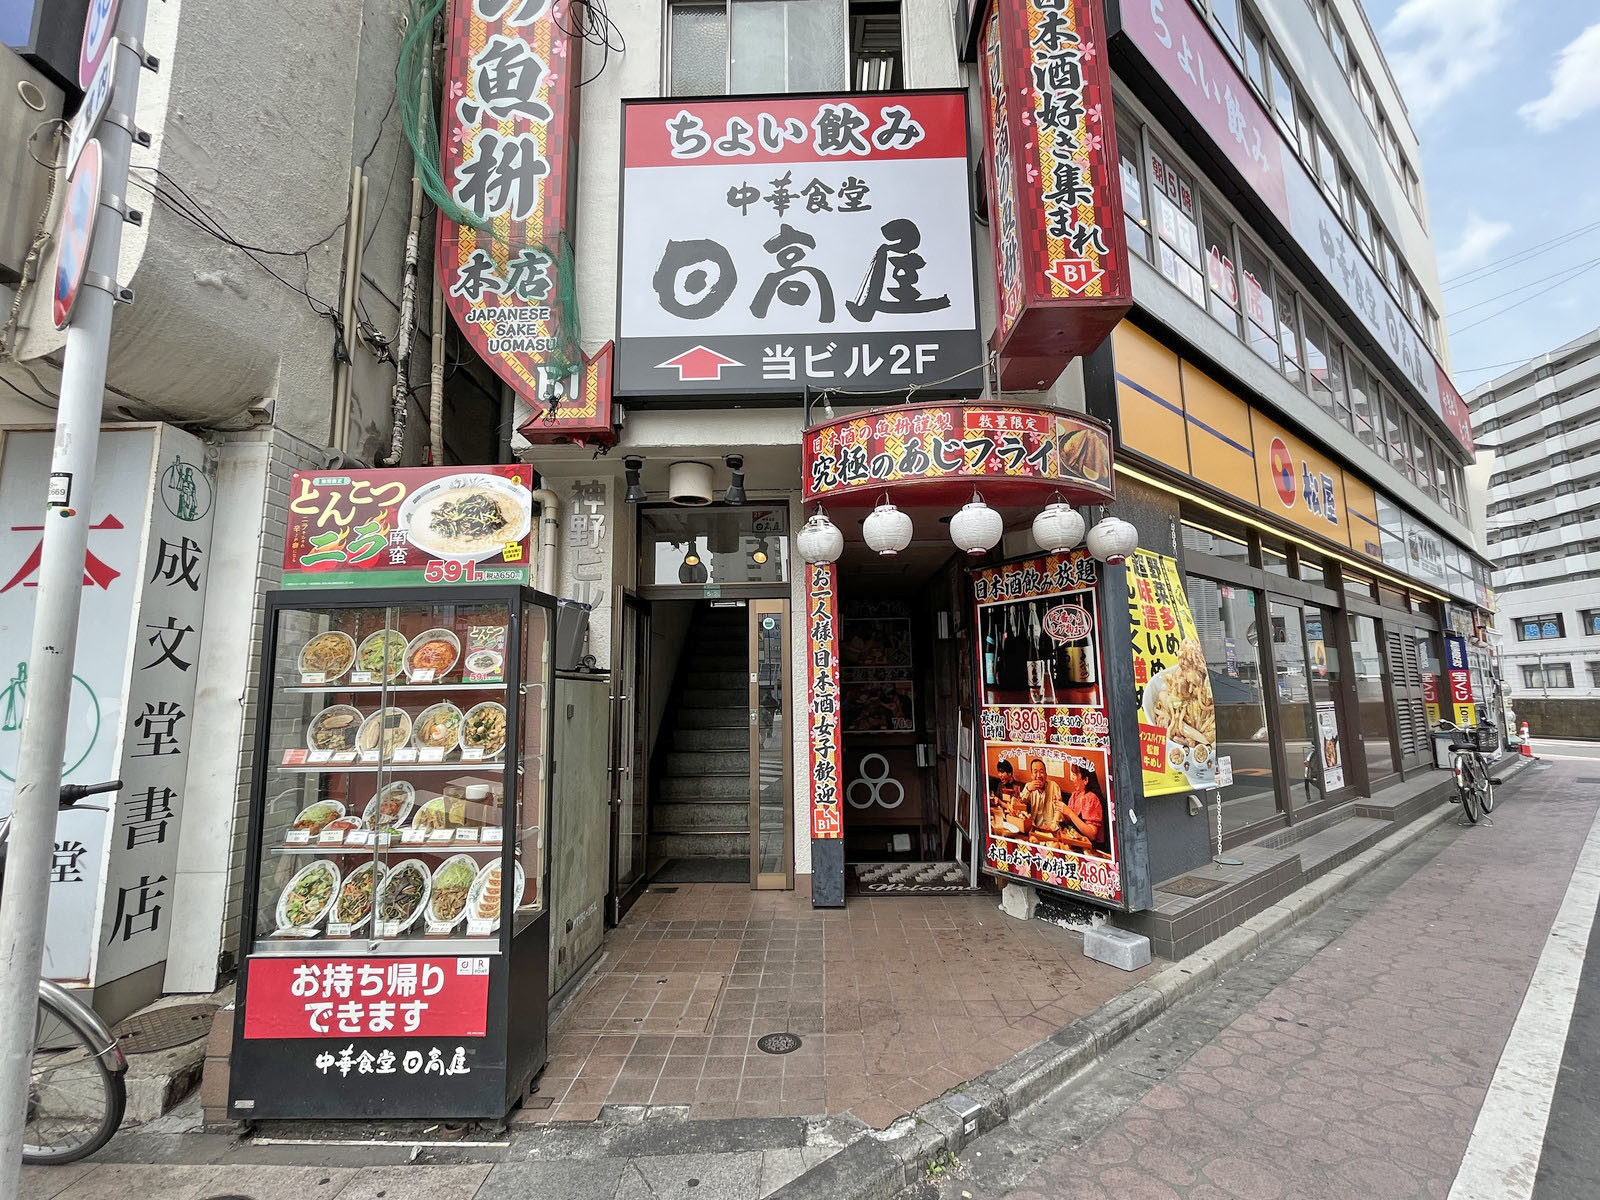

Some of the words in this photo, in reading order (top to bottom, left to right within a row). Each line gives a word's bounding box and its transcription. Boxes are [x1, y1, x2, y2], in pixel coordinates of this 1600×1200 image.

[667, 103, 925, 158] ちょい飲み
[727, 170, 872, 217] 中華食堂
[451, 250, 553, 301] 本店
[653, 218, 950, 323] 日高屋
[1064, 265, 1087, 282] B1
[467, 308, 550, 321] JAPANESE
[496, 324, 537, 336] SAKE
[489, 338, 557, 351] UOMASU
[762, 343, 939, 380] 当ビル2F
[812, 412, 953, 454] 日本酒の魚枡謹製
[978, 412, 1039, 431] 数量限定
[811, 436, 1056, 492] 究極のあじフライ
[290, 479, 406, 527] とんこつ
[1301, 459, 1338, 526] 松屋
[300, 521, 389, 567] ニラ
[389, 529, 409, 565] 南蛮
[570, 480, 606, 609] 神野ビル
[424, 560, 483, 582] 591円
[975, 557, 1097, 600] 日本酒飲み放題
[107, 536, 202, 947] 成文堂書店
[818, 819, 831, 830] B1
[988, 845, 1077, 880] 本日のおすすめ料理
[868, 883, 981, 891] Welcome
[291, 963, 445, 997] お持ち帰り
[304, 1000, 429, 1033] できます
[315, 1044, 396, 1078] 中華食堂
[403, 1046, 471, 1076] 日高屋
